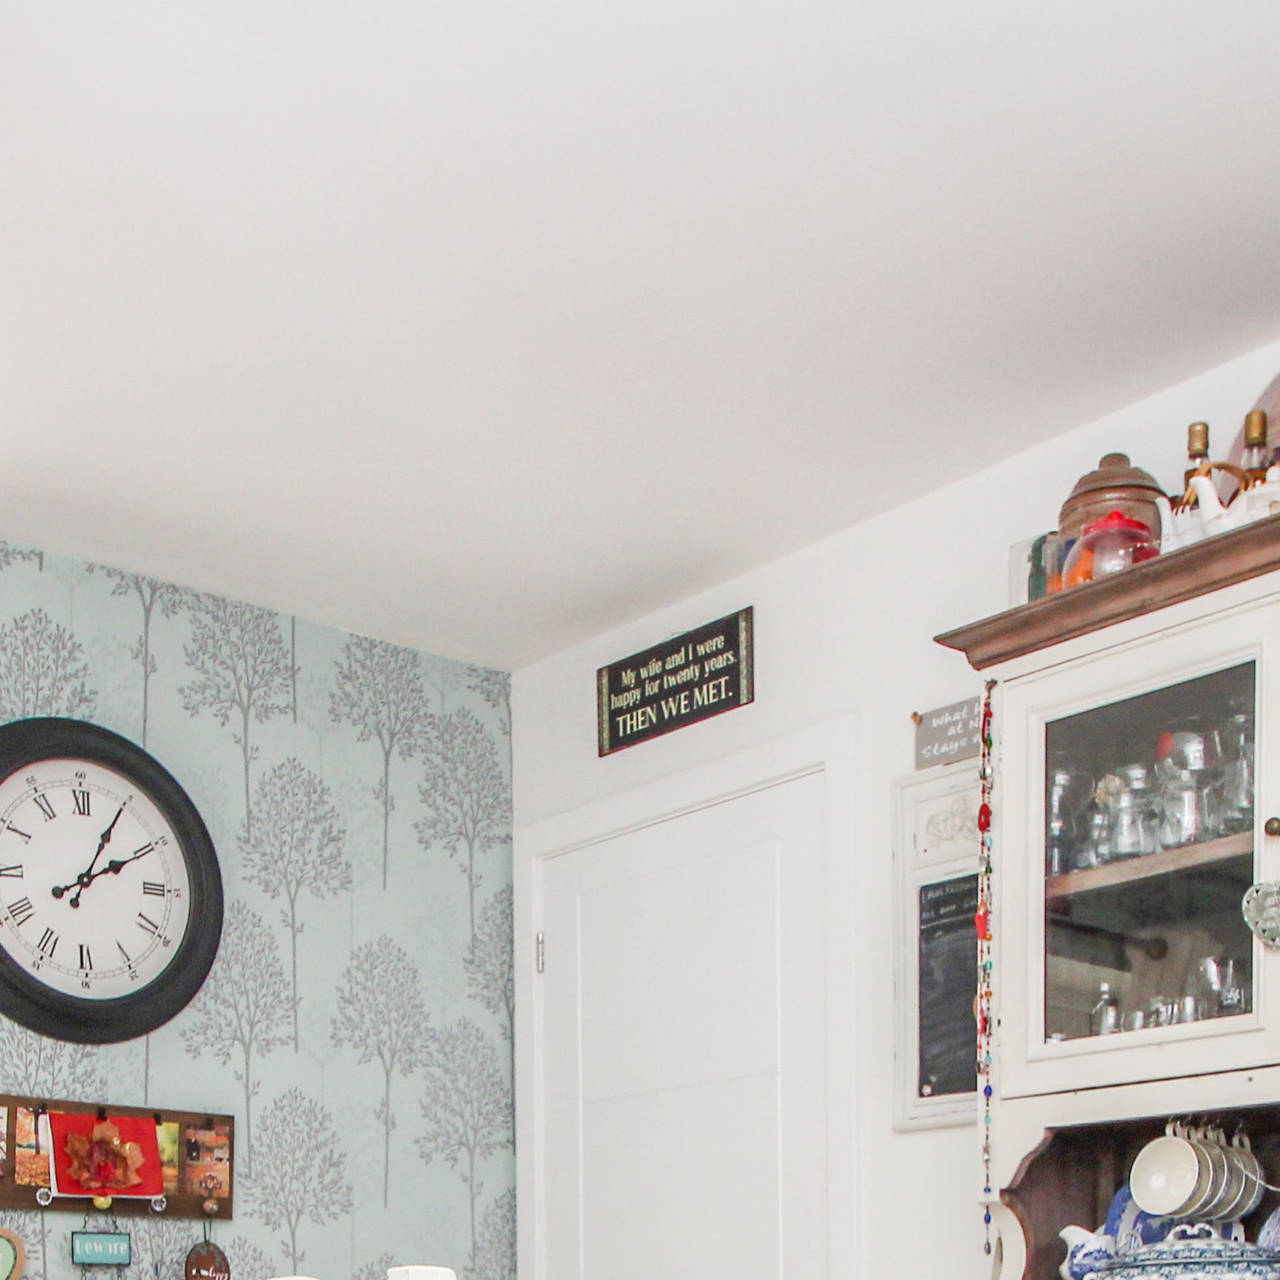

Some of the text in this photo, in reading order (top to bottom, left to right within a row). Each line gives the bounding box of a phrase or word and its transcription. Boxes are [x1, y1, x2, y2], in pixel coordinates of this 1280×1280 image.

[611, 687, 641, 710] happy
[645, 680, 661, 696] for
[663, 663, 700, 689] twenty
[621, 668, 636, 688] My
[640, 658, 662, 679] wife
[665, 646, 685, 669] and
[696, 635, 725, 656] were
[616, 676, 733, 737] THEN WE MET.
[72, 789, 91, 816] XII
